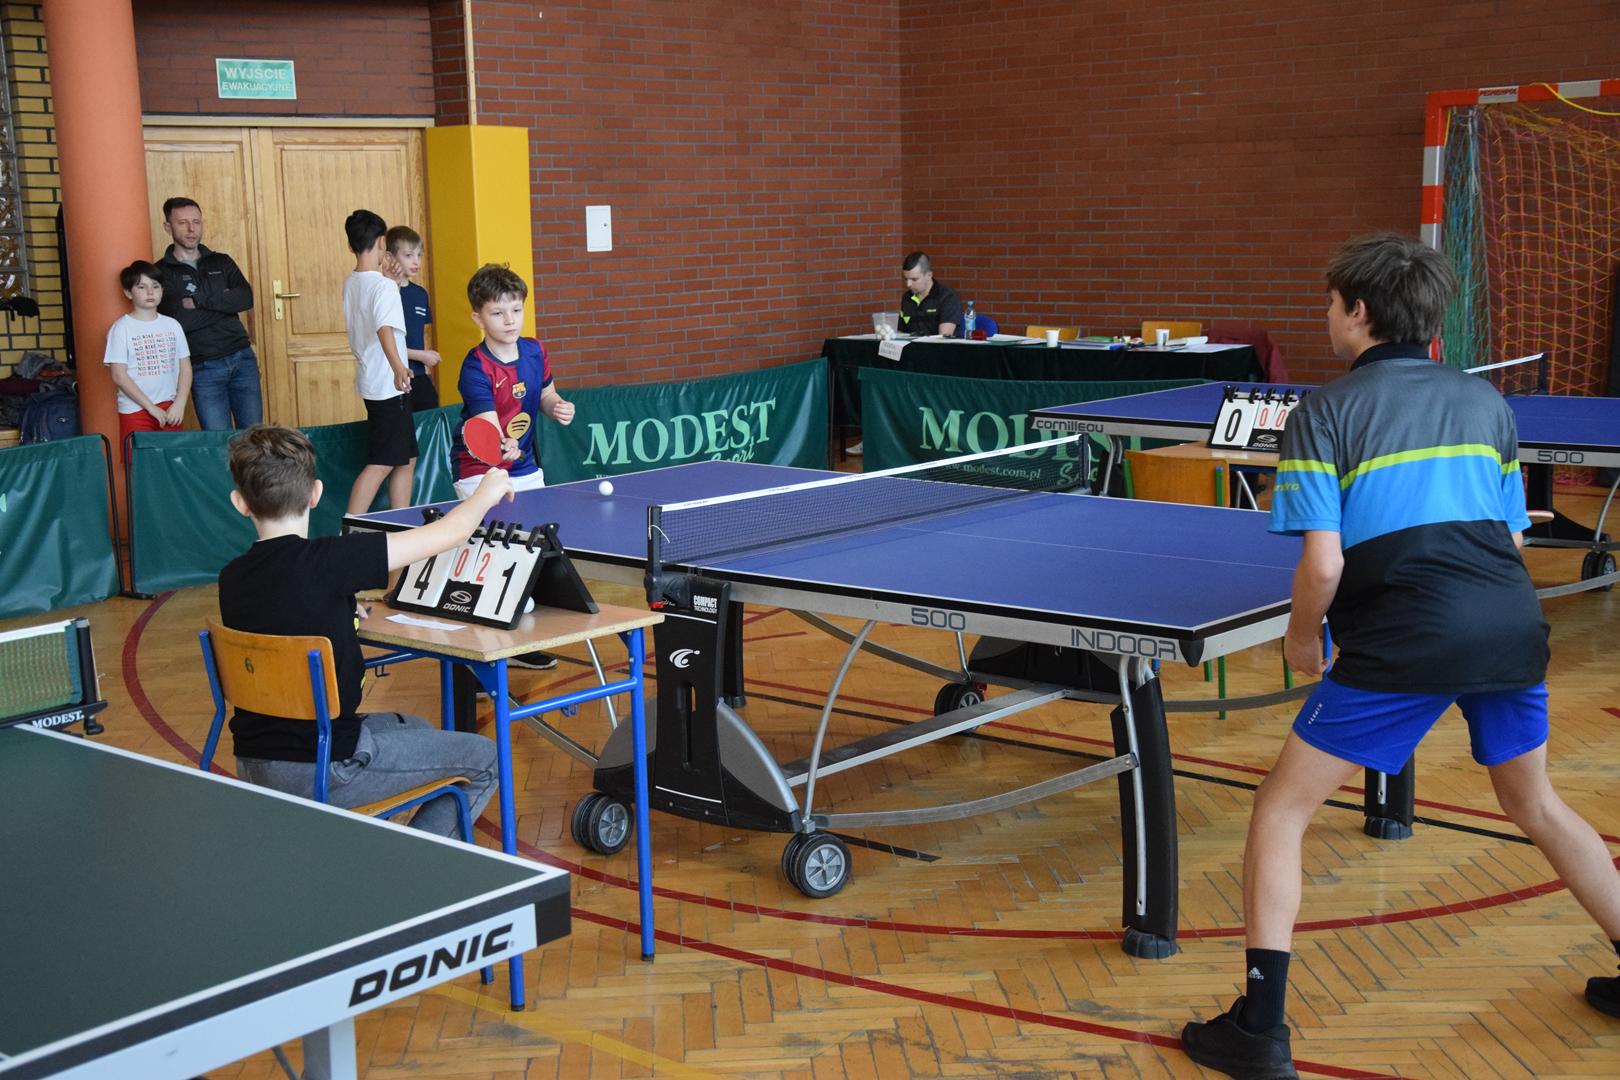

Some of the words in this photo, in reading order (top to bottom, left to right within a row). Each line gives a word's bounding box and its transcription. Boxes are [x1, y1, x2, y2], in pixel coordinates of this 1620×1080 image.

[583, 397, 776, 465] MODEST
[1224, 408, 1242, 442] 0
[1259, 408, 1269, 427] 0
[1275, 409, 1287, 428] 0
[1537, 450, 1584, 464] 500
[413, 553, 438, 600] 4
[454, 548, 469, 577] 0
[475, 552, 491, 582] 2
[495, 561, 517, 615] 1
[693, 594, 718, 608] COMPACT
[442, 603, 472, 613] DONIC
[911, 607, 966, 631] 500
[1070, 627, 1176, 660] INDOOR
[348, 922, 513, 1008] DONIC
